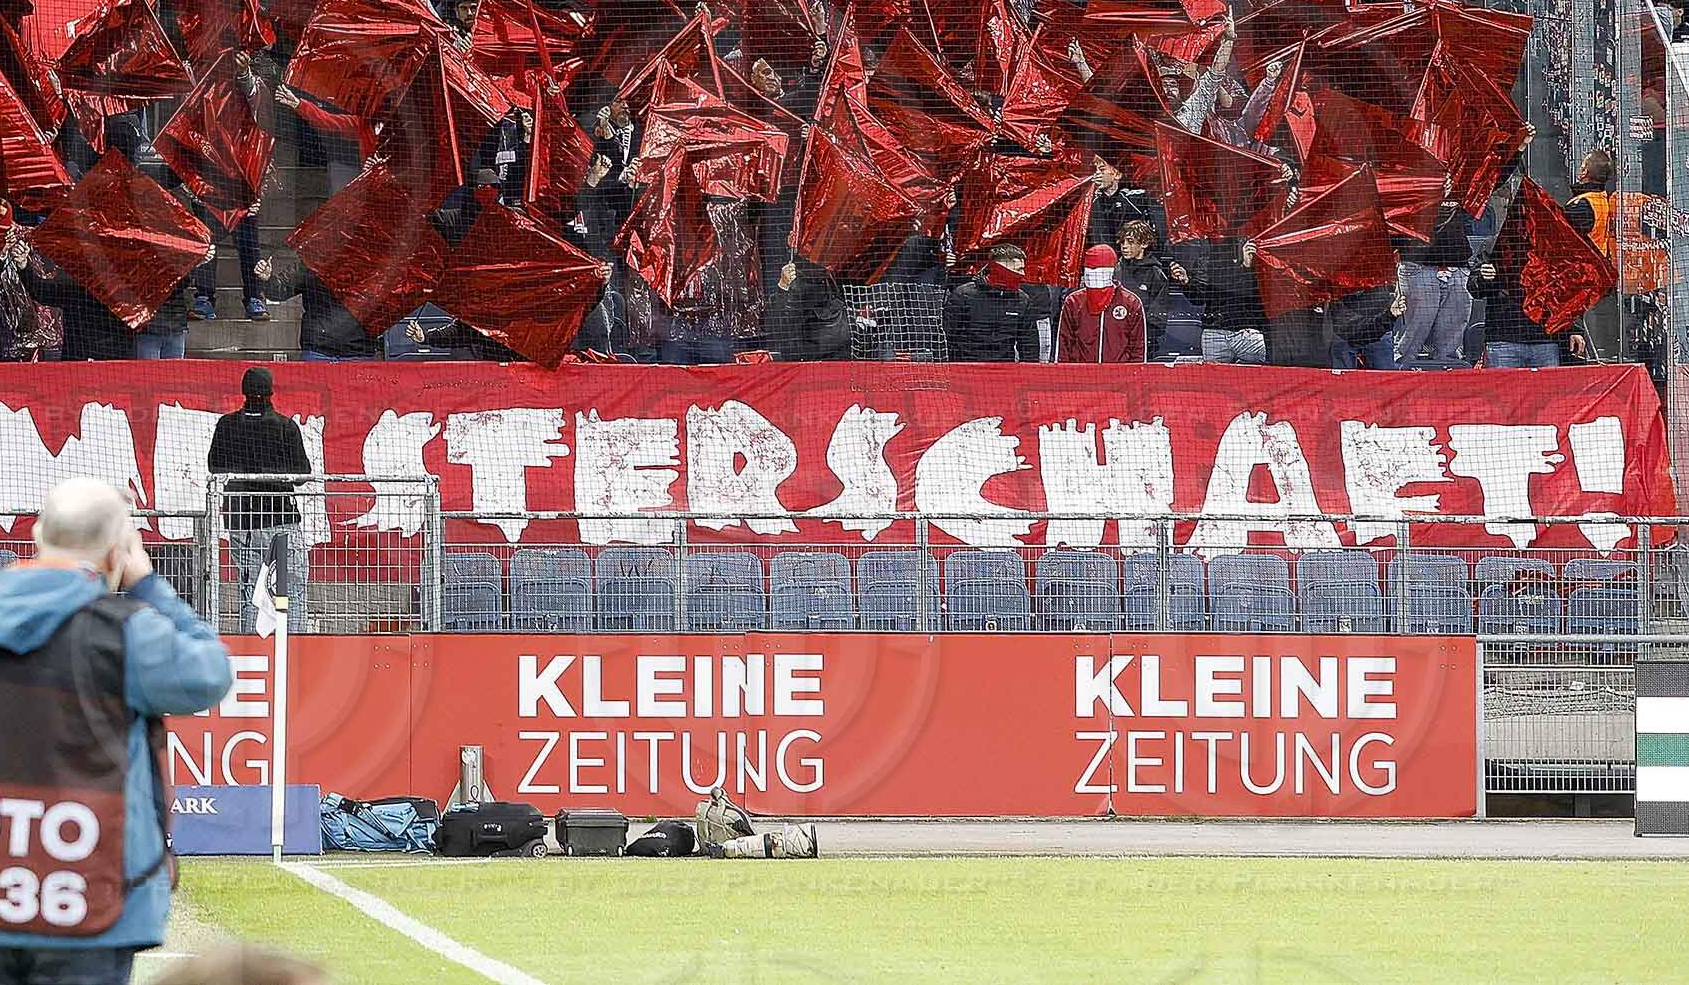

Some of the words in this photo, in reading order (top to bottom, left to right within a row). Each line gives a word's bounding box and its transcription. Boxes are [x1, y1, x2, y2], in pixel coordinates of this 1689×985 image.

[518, 654, 825, 718] KLEINE
[1075, 656, 1397, 719] KLEINE
[518, 729, 825, 796] ZEITUNG
[1075, 731, 1397, 796] ZEITUNG
[171, 797, 218, 815] ARK
